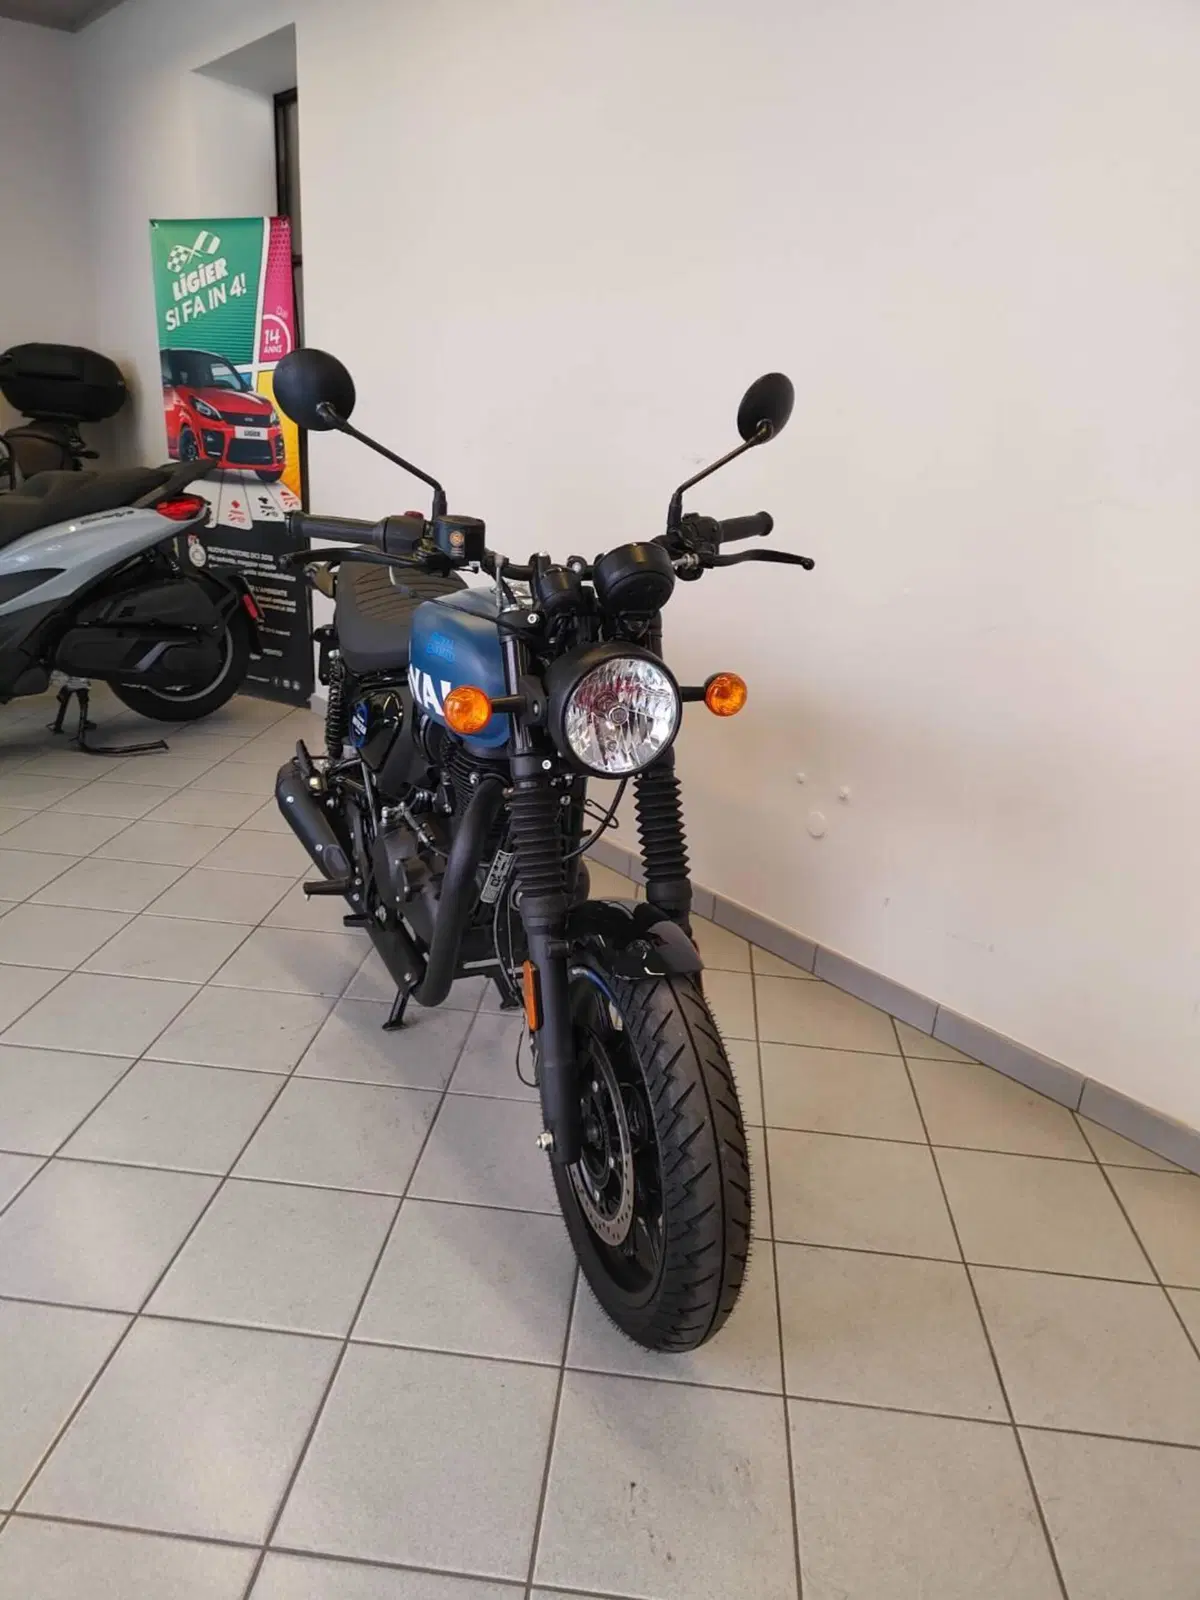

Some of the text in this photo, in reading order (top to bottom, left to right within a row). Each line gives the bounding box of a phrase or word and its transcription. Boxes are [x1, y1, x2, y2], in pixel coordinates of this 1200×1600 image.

[165, 272, 247, 331] SI FA IN 4!
[264, 328, 281, 345] 14
